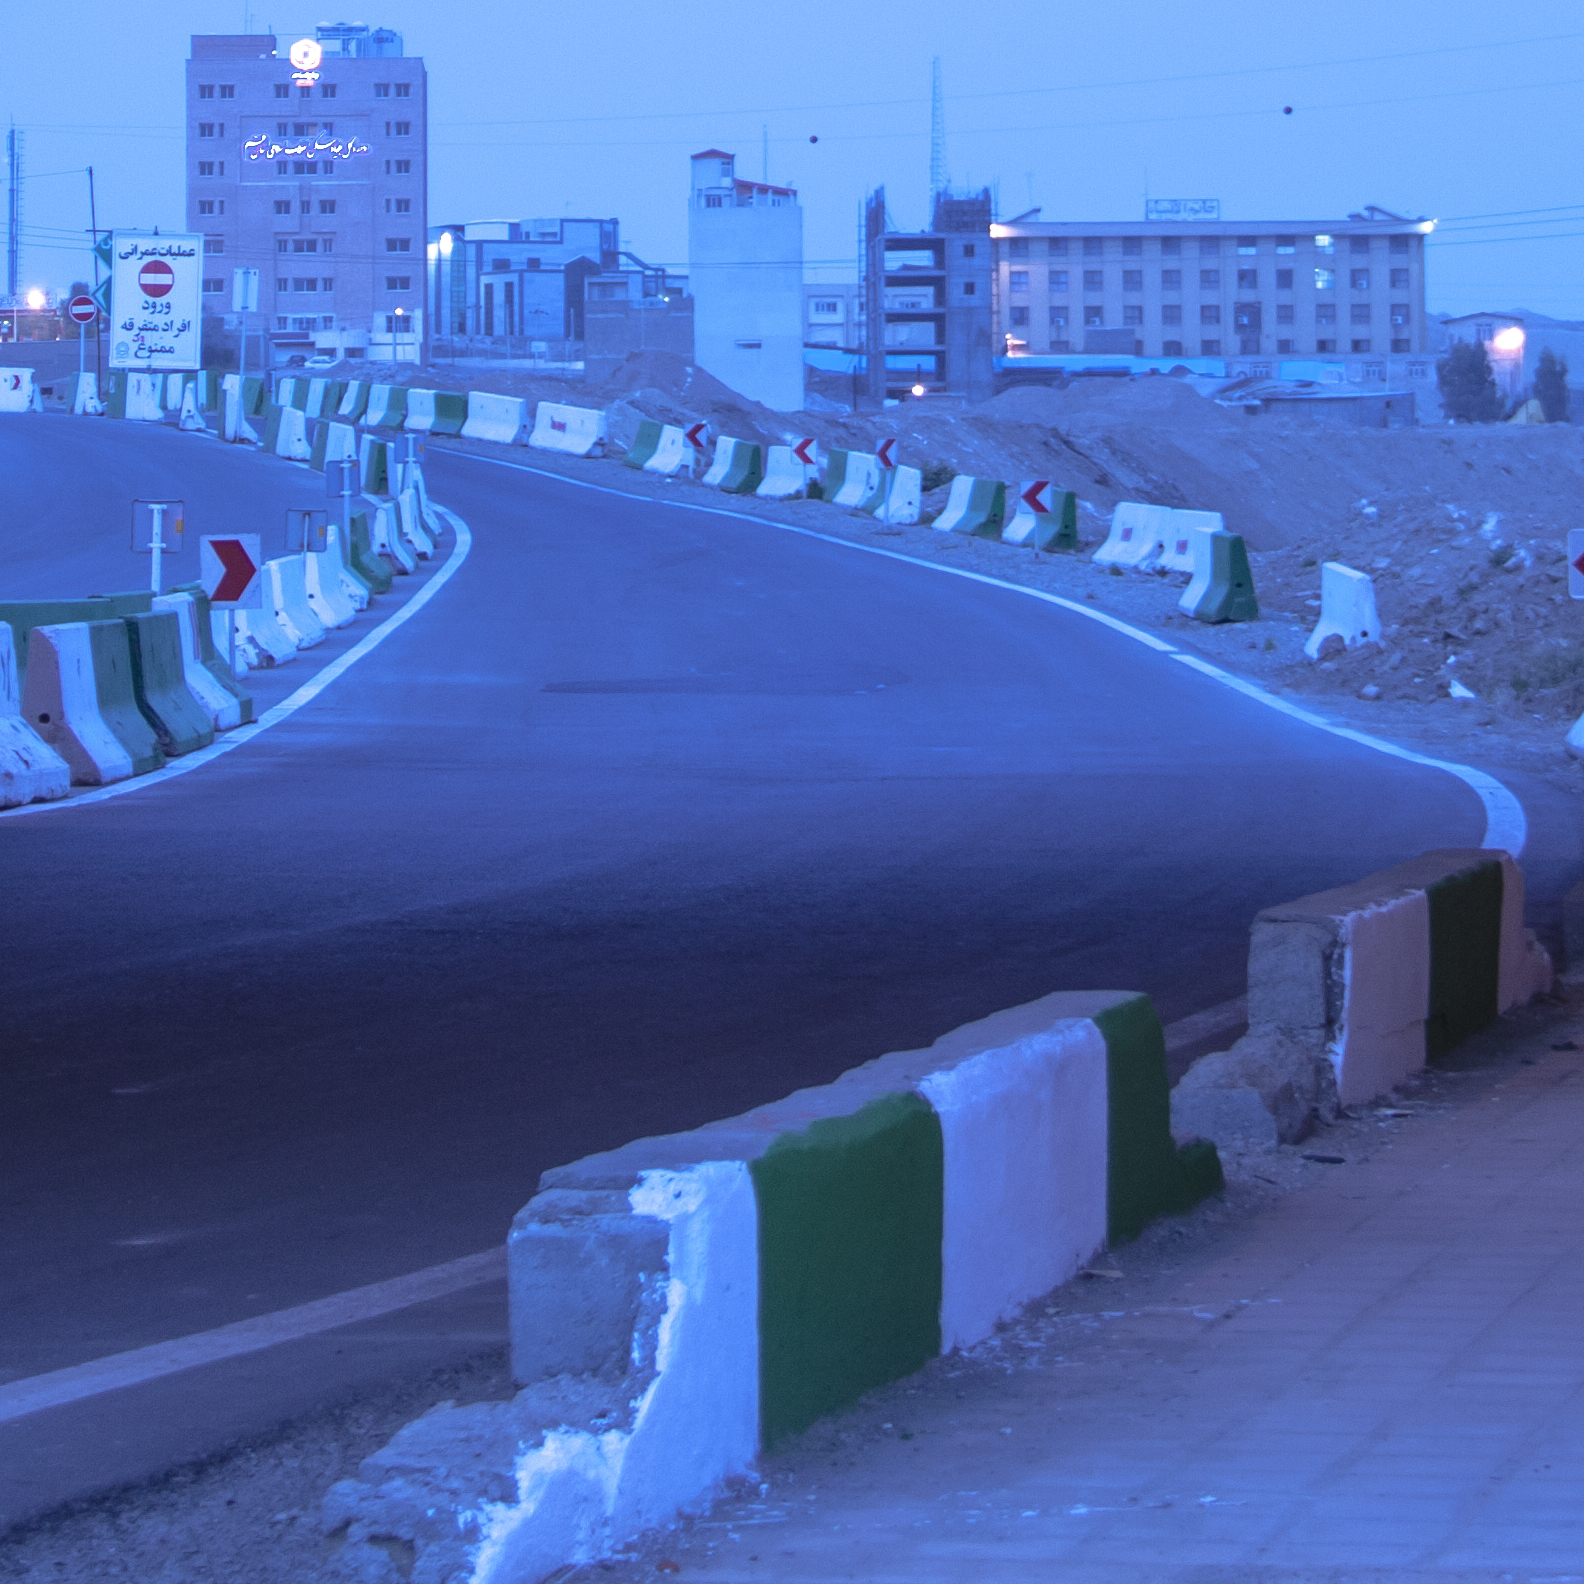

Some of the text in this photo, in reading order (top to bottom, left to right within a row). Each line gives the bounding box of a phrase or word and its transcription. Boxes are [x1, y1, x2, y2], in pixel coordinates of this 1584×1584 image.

[118, 244, 195, 260] عملیات عمرانی
[142, 300, 171, 315] ورود
[120, 318, 191, 337] افراد متفرقه
[134, 341, 174, 359] ممنوع
